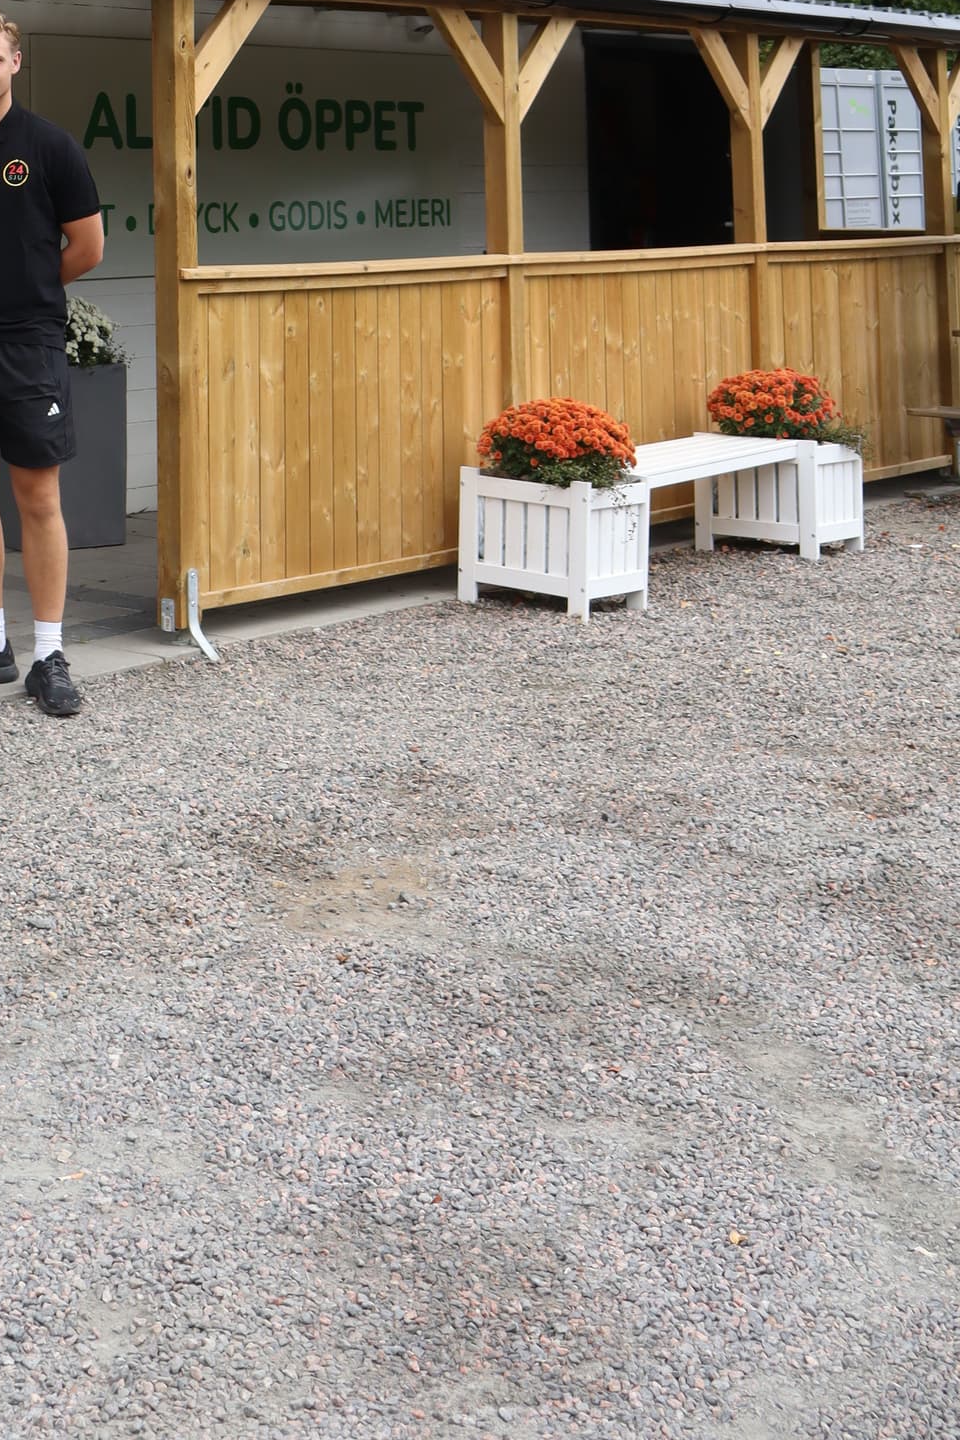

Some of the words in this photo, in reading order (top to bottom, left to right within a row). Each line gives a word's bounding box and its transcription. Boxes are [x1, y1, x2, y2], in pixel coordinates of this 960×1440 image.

[83, 91, 261, 151] ALID
[278, 82, 424, 151] ÖPPET
[8, 163, 24, 175] 24
[269, 200, 347, 232] GODIS
[374, 198, 451, 228] MEJERI
